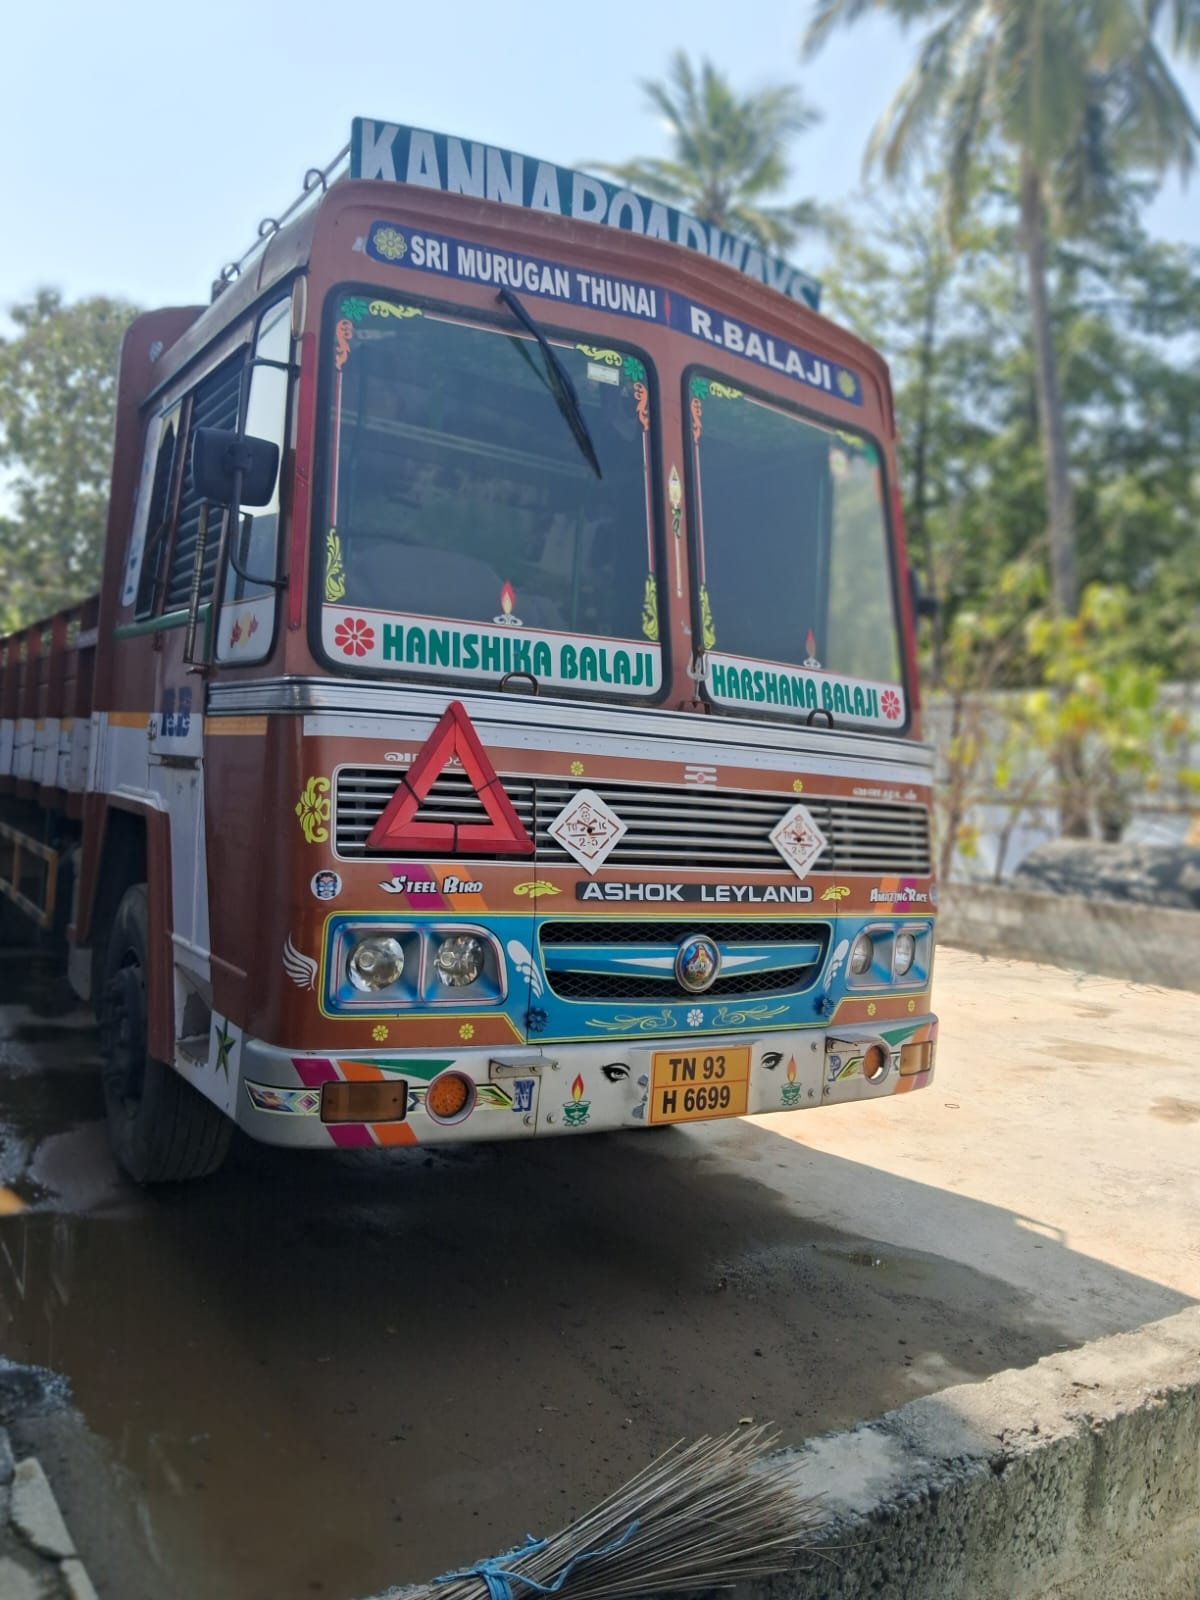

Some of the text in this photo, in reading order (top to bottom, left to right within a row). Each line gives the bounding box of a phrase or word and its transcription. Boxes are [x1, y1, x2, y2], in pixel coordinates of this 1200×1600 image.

[411, 235, 656, 318] SRI MURUGAN THUNAI
[690, 306, 832, 390] R.BALAJI
[383, 623, 653, 687] HANISHIKA BALAJI
[712, 664, 879, 718] HARSHANA BALAJI
[378, 876, 483, 893] STEEL BIRD
[583, 883, 813, 903] ASHOK LEYLAND
[669, 1056, 726, 1081] TN 93
[662, 1085, 730, 1114] H 6699
